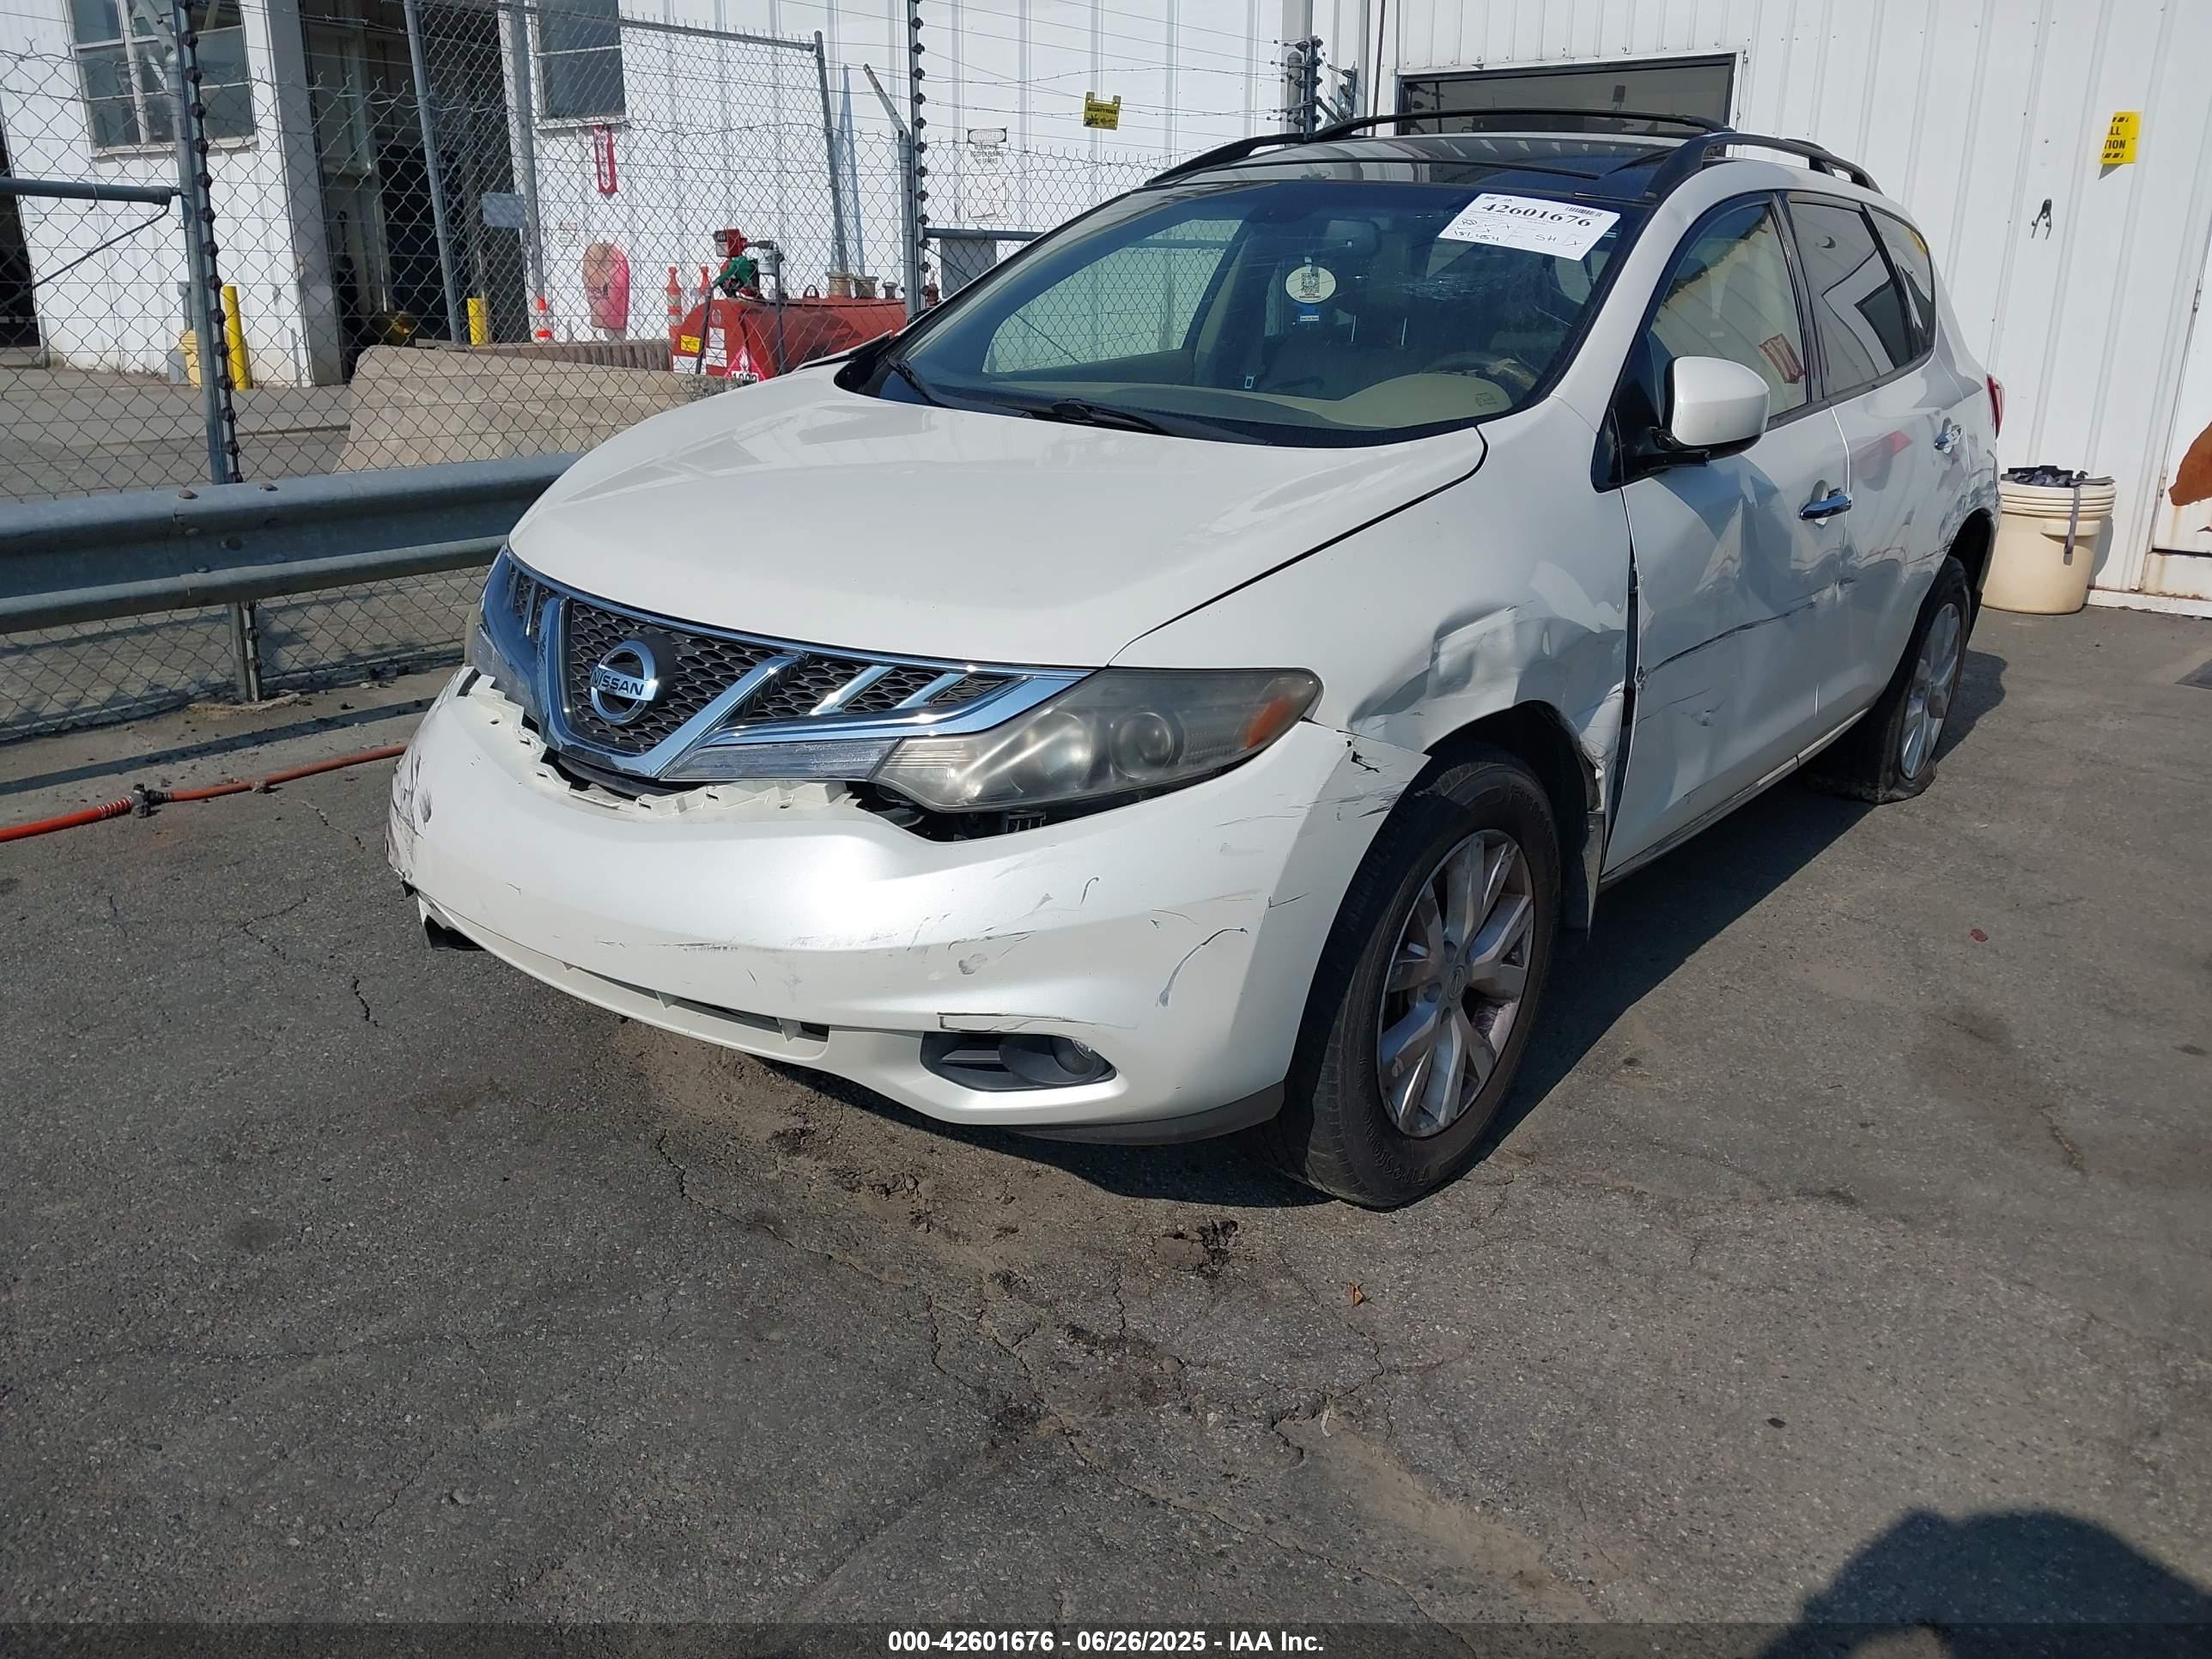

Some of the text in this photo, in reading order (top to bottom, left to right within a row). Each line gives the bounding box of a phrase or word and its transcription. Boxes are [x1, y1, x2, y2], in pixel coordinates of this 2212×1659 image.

[2108, 125, 2121, 136] LL
[1482, 204, 1593, 227] 42601676
[591, 667, 645, 696] NISSAN
